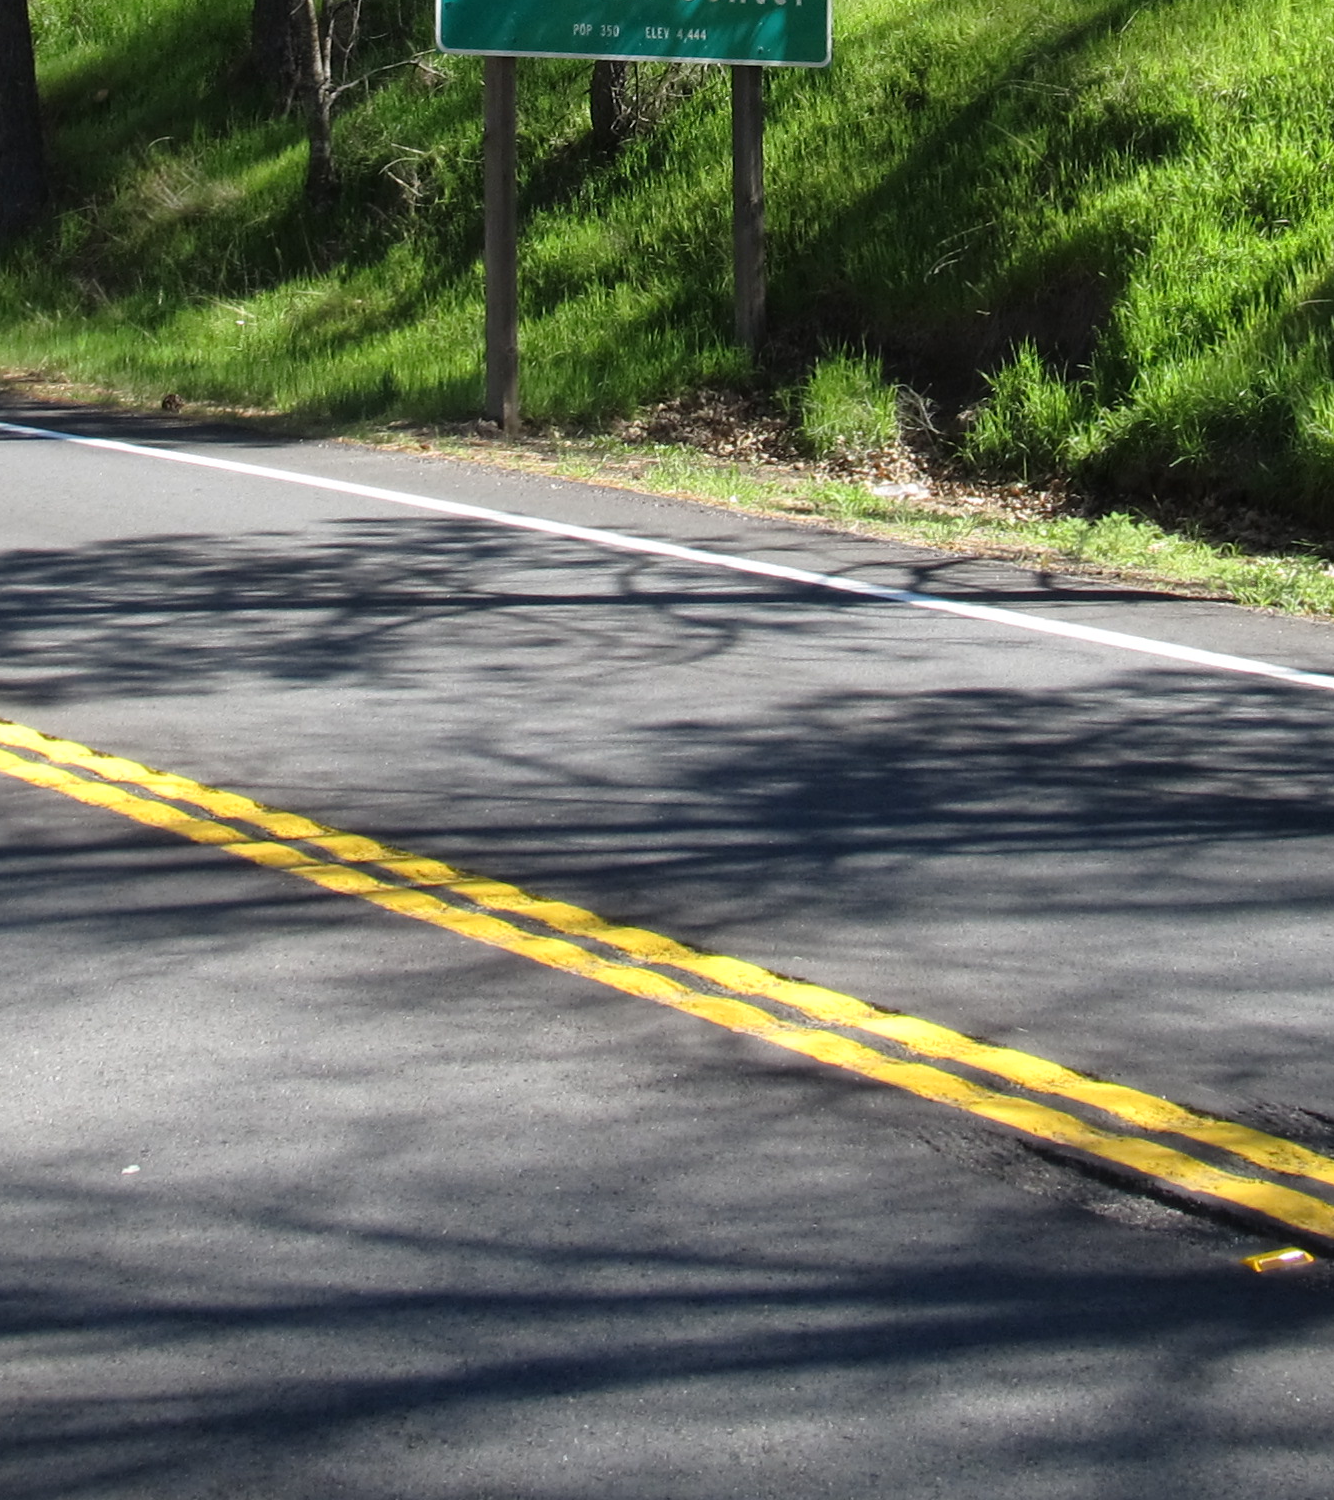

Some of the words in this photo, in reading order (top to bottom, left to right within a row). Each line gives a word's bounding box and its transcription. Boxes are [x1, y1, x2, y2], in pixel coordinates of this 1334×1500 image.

[573, 23, 593, 37] POP
[600, 24, 620, 37] 350
[645, 26, 670, 40] ELEV
[676, 28, 707, 43] 4,444
